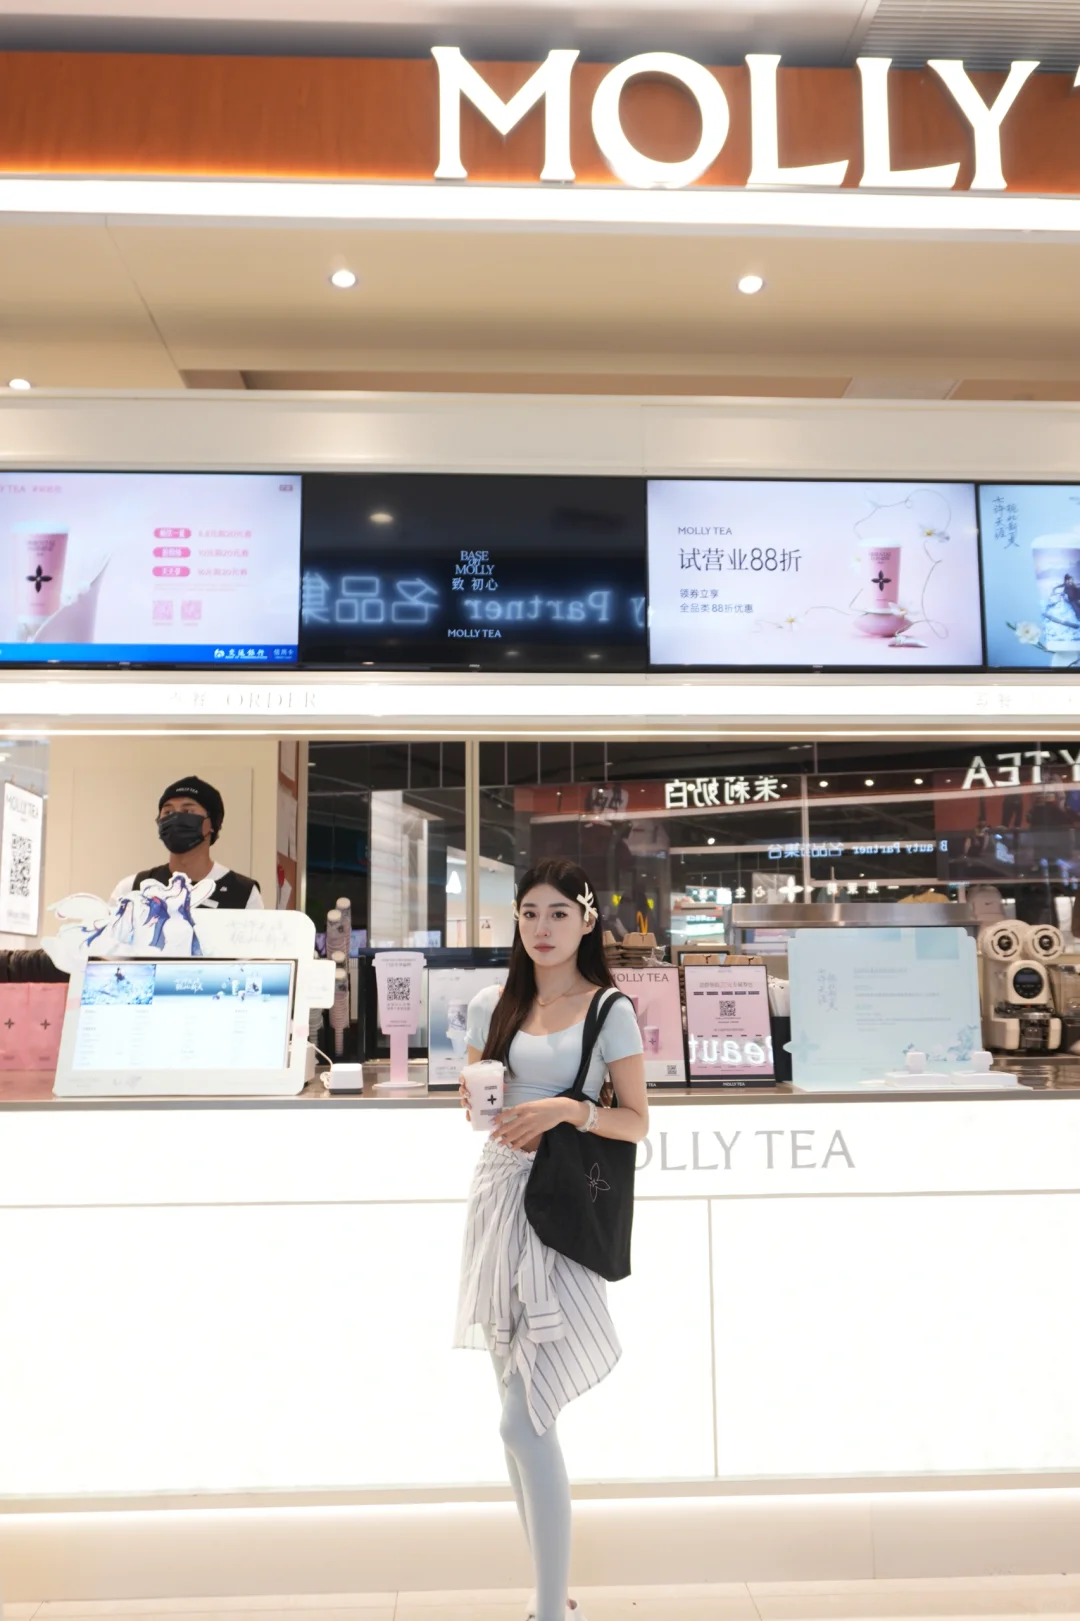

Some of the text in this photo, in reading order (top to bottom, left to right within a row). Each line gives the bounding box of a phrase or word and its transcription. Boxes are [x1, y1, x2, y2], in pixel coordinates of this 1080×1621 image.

[430, 46, 1041, 190] MOLLY
[678, 526, 733, 536] MOLLY TEA
[460, 550, 490, 561] BASE
[678, 547, 802, 572] 试营业88折
[454, 564, 496, 575] MOLLY
[451, 577, 499, 591] 致 初心
[680, 603, 754, 613] 全品类88折优惠
[447, 629, 502, 638] MOLLY TEA
[646, 972, 670, 983] TEA
[754, 1129, 857, 1169] TEA
